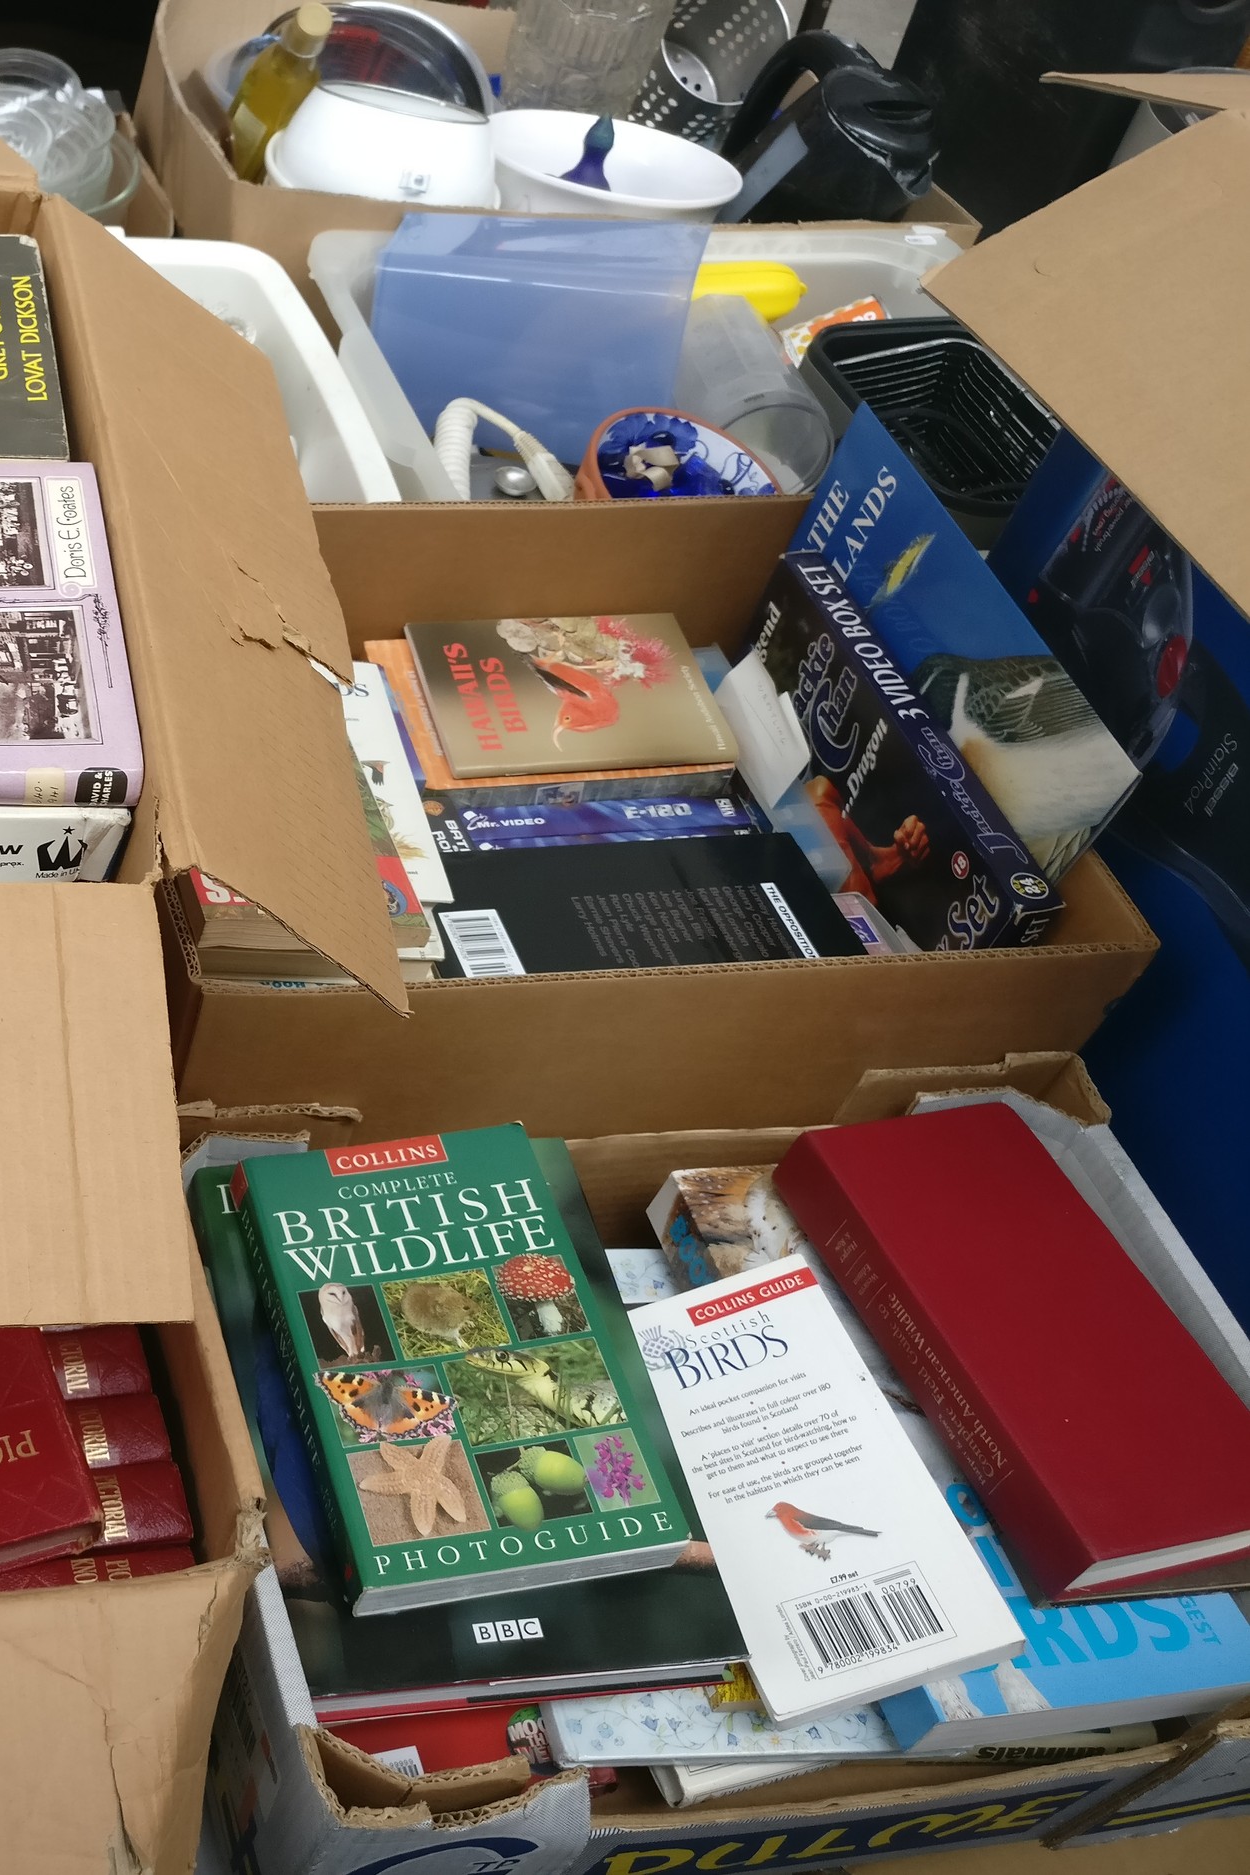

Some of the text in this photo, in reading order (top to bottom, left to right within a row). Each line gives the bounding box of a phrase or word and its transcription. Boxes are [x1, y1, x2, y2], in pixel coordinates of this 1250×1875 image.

[11, 276, 48, 401] LOVAT DICKSON
[56, 486, 82, 525] Coates
[807, 480, 850, 553] THE
[63, 542, 87, 578] Doris
[797, 563, 930, 721] 3 VIDEO BOX SET
[443, 643, 503, 751] HAWAII'S
[479, 657, 528, 733] BIRDS
[500, 817, 546, 827] VIDEO
[624, 803, 693, 820] E-180
[765, 886, 781, 904] THE
[1020, 918, 1050, 944] SET
[336, 1144, 438, 1170] COLLINS
[338, 1172, 458, 1200] COMPLETE
[273, 1178, 543, 1246] BRITISH
[283, 1215, 555, 1281] WILDLIFE
[694, 1274, 805, 1320] COLLINS GUIDE
[685, 1310, 771, 1349] Scottish
[664, 1325, 789, 1391] BIRDS
[700, 1402, 716, 1411] ideal
[718, 1395, 740, 1407] pocket
[741, 1383, 777, 1398] companion
[790, 1373, 806, 1381] visits
[878, 1302, 995, 1478] Complete Field Guide to
[888, 1292, 1008, 1469] North American Wildlife
[681, 1425, 711, 1437] Describes
[713, 1419, 725, 1427] and
[726, 1410, 758, 1422] illustrates
[767, 1401, 778, 1409] full
[780, 1395, 800, 1405] colour
[803, 1389, 817, 1397] over
[818, 1383, 830, 1391] 180
[722, 1425, 739, 1434] birds
[740, 1416, 761, 1428] found
[769, 1404, 798, 1418] Scotland
[757, 1432, 780, 1442] section
[782, 1424, 803, 1434] details
[804, 1418, 818, 1427] over
[819, 1413, 830, 1421] 70
[708, 1491, 719, 1499] For
[722, 1487, 736, 1498] ease
[773, 1469, 791, 1478] birds
[804, 1454, 833, 1469] grouped
[834, 1445, 862, 1458] together
[746, 1485, 773, 1497] habitats
[782, 1474, 803, 1485] which
[804, 1469, 819, 1478] they
[845, 1456, 860, 1464] seen
[93, 1475, 129, 1542] PICTORIAL
[373, 1511, 673, 1575] PHOTOGUIDE
[71, 1557, 99, 1583] KNO
[105, 1558, 132, 1580] PIC
[847, 1571, 859, 1580] net
[881, 1578, 916, 1595] 00799
[794, 1600, 812, 1611] ISBN
[1178, 1595, 1223, 1646] GEST
[478, 1620, 539, 1641] BBC
[817, 1643, 899, 1674] 9 780002 199834
